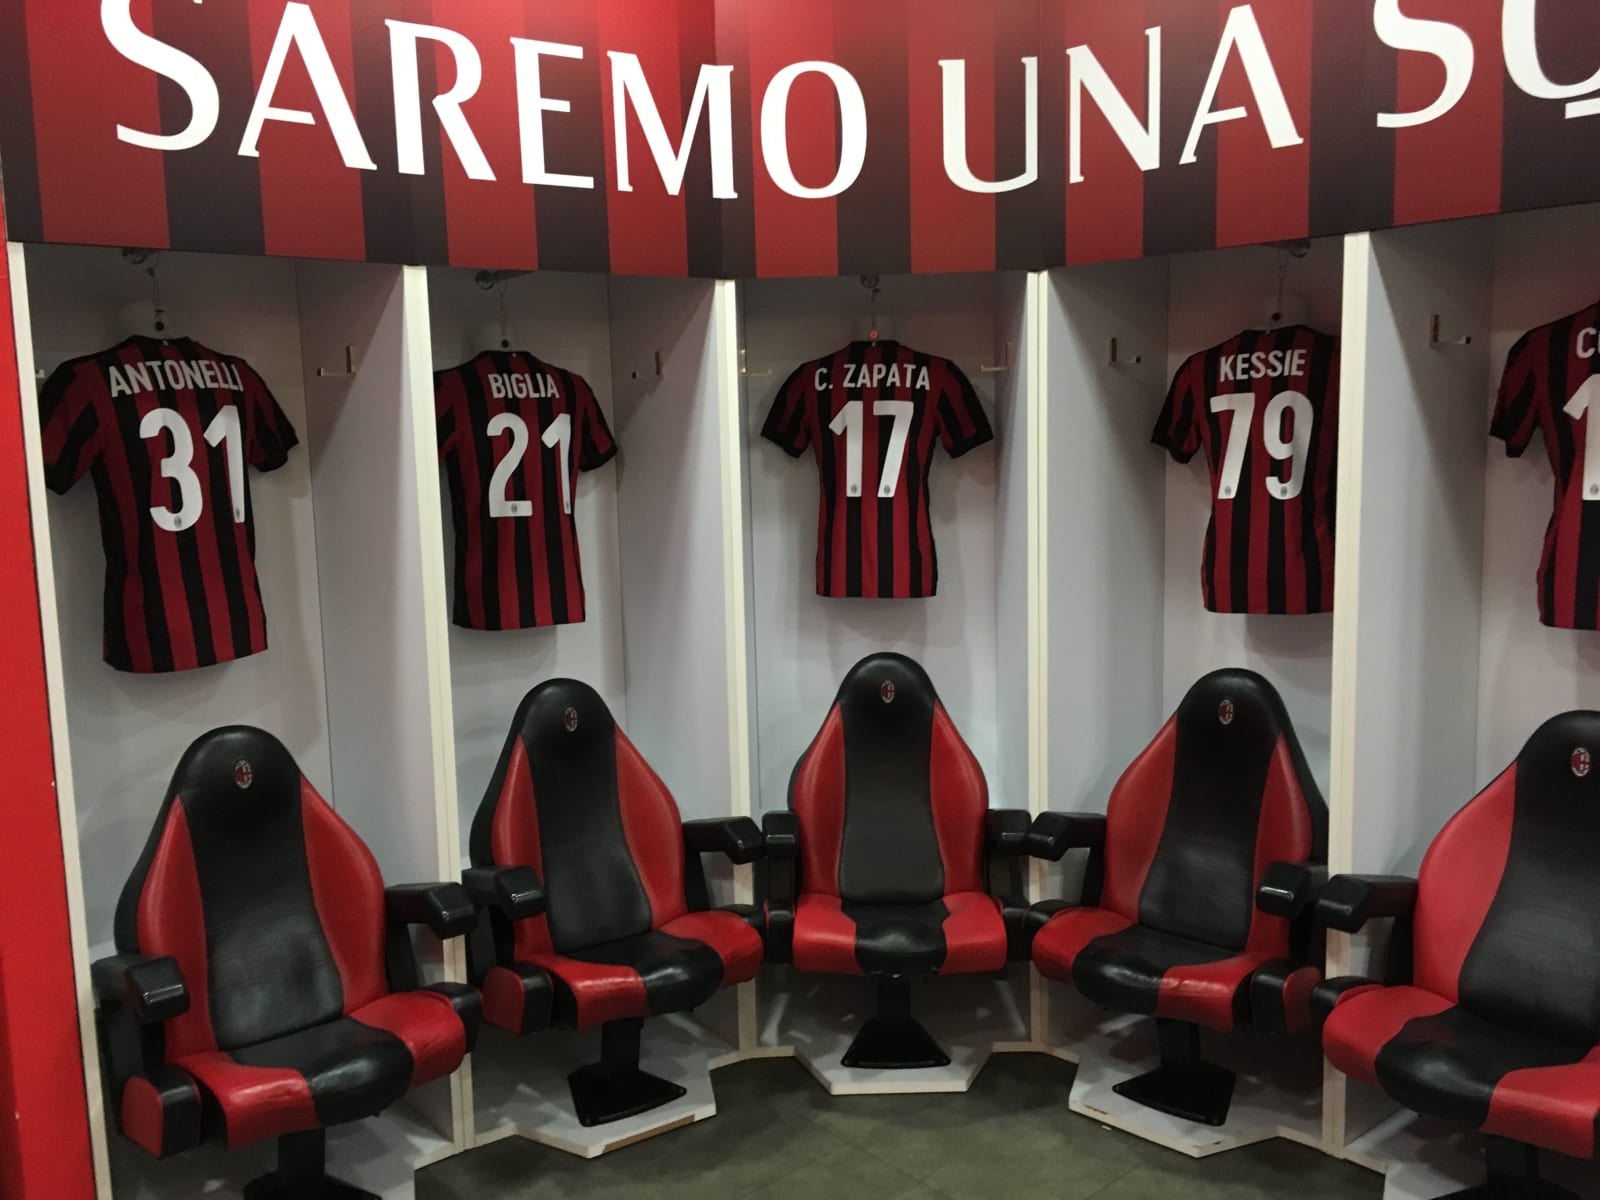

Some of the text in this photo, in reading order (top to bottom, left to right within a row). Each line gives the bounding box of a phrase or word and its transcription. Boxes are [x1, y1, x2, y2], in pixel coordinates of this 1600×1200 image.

[101, 0, 867, 199] SAREMO
[938, 4, 1304, 193] UNA
[108, 359, 244, 398] ANTONELLI
[487, 373, 560, 399] BIGLIA
[814, 363, 930, 391] C. ZAPATA
[1219, 349, 1307, 382] KESSIE
[139, 405, 245, 532] 31
[486, 412, 572, 518] 21
[828, 400, 914, 498] 17
[1210, 390, 1314, 500] 79
